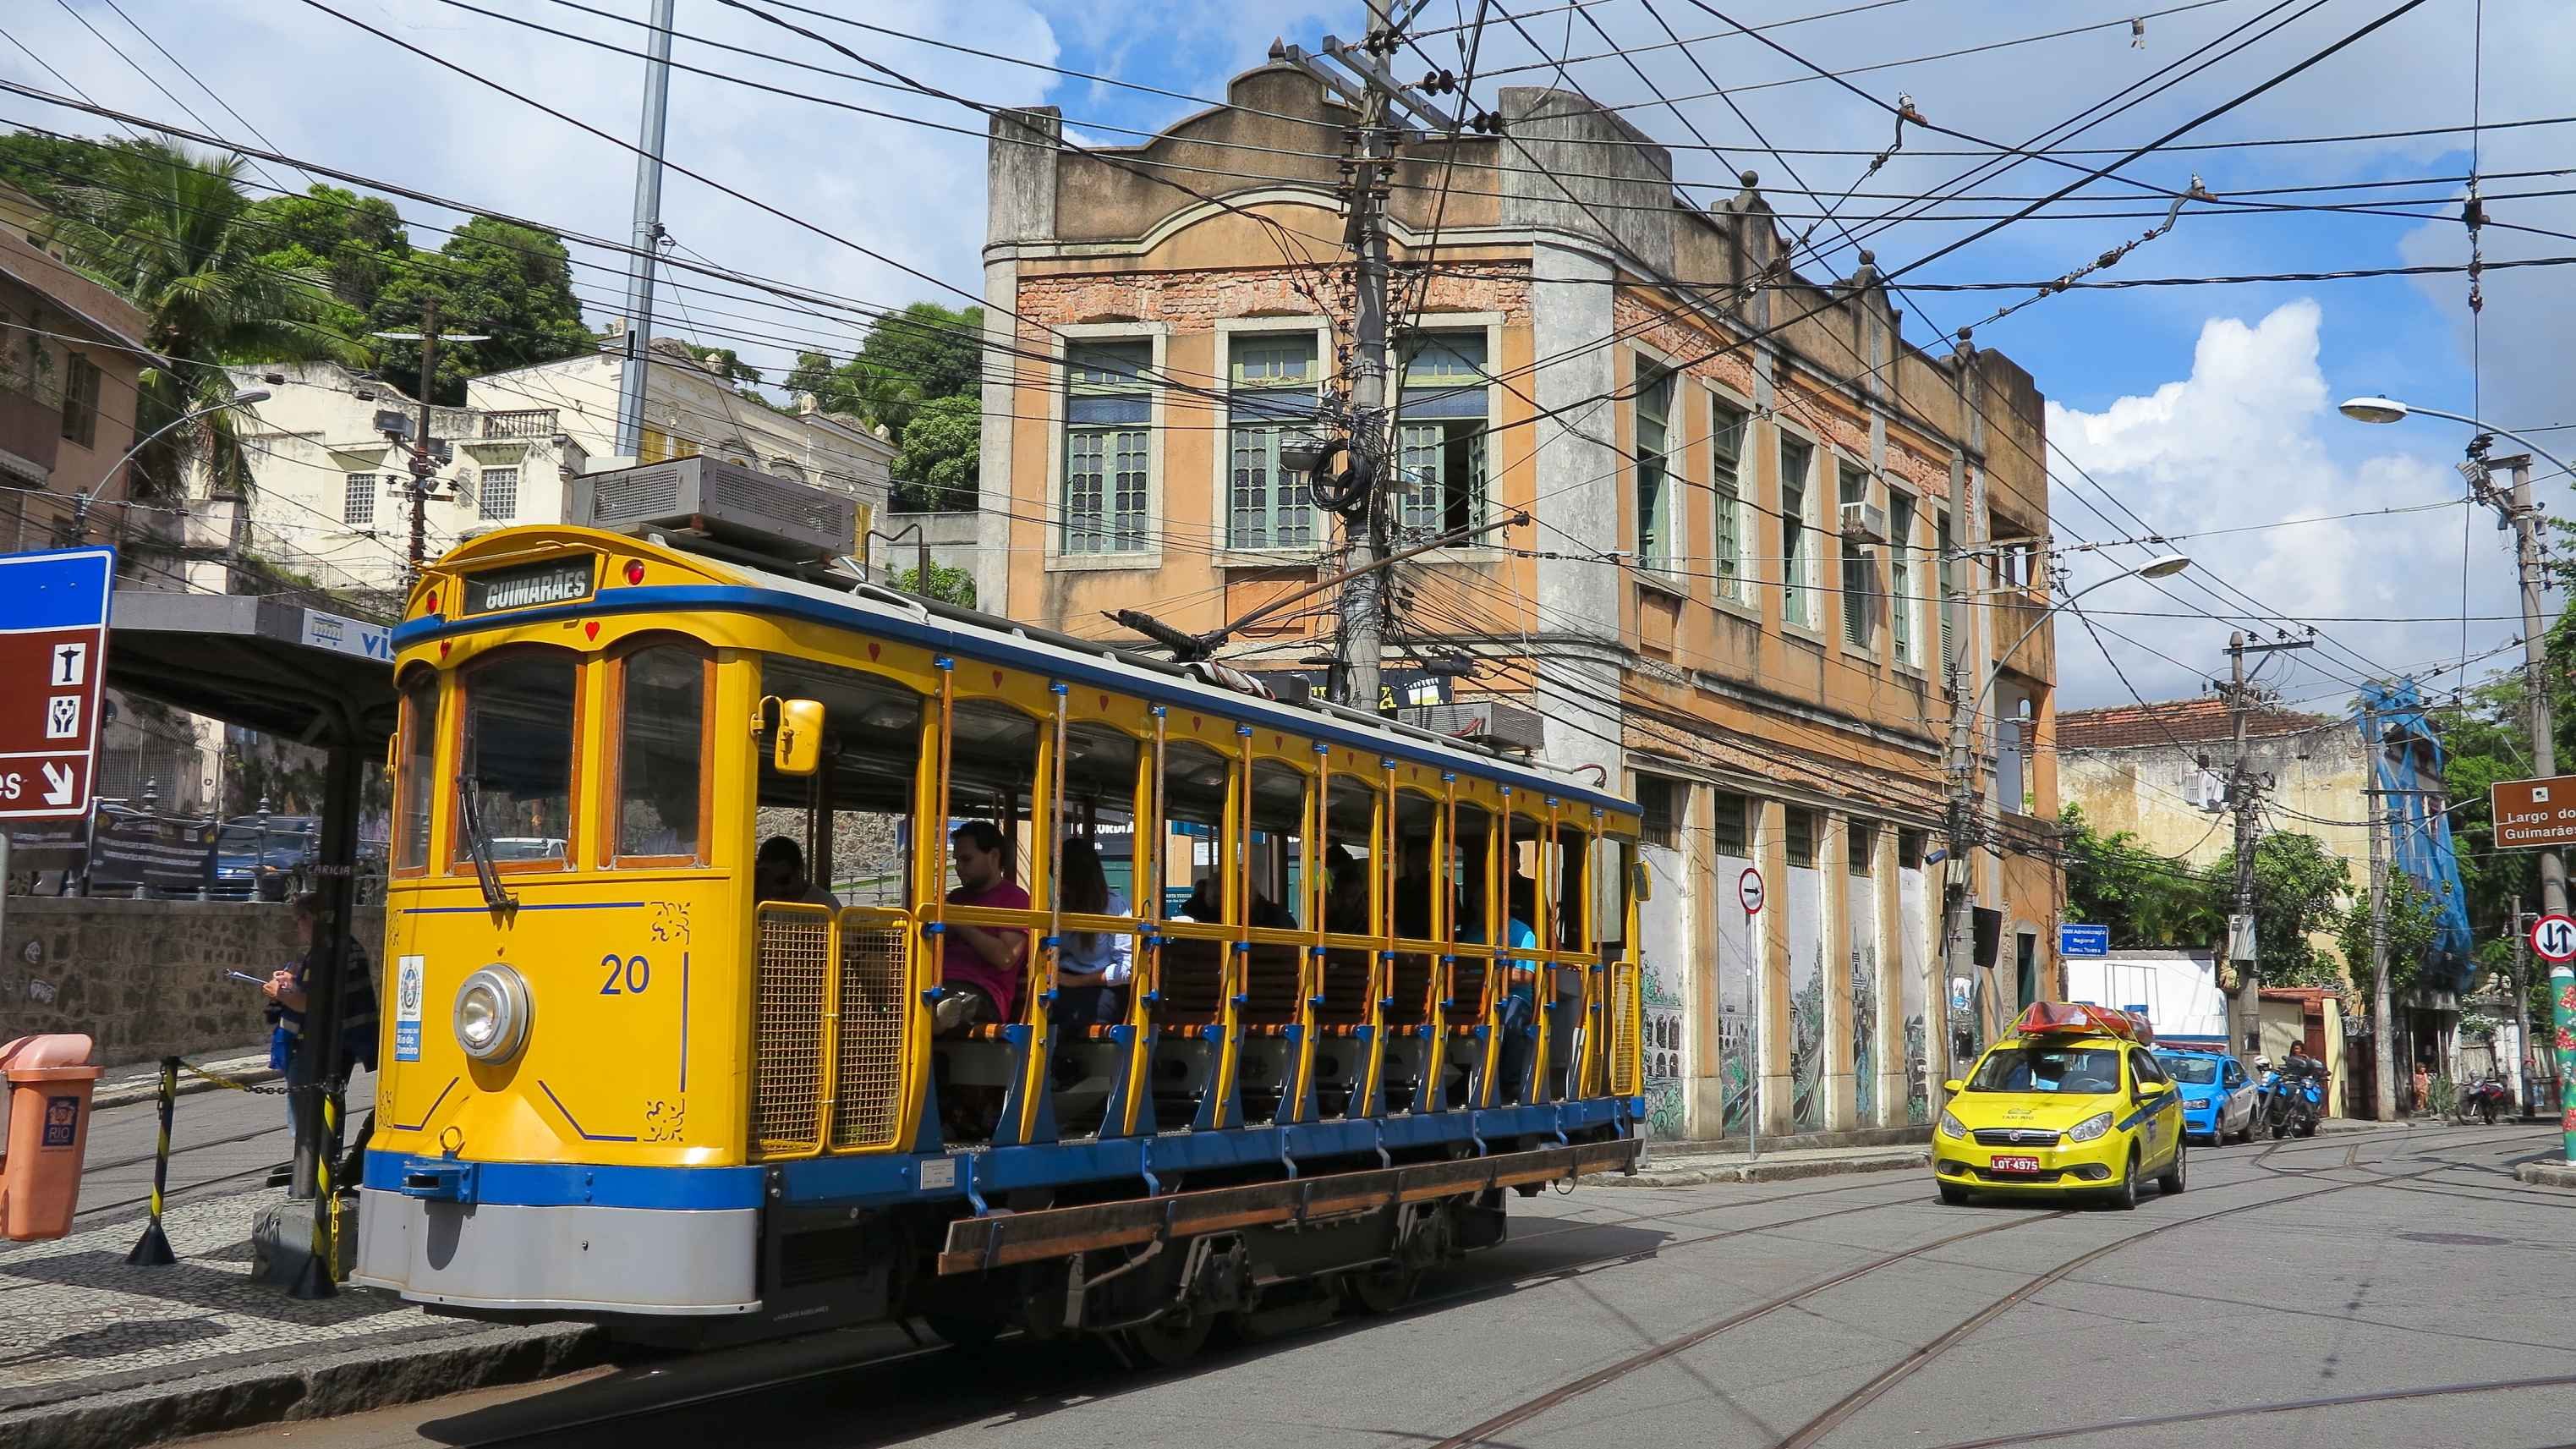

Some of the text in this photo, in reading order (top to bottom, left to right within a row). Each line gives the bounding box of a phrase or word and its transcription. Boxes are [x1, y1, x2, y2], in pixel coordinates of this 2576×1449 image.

[485, 568, 586, 610] GUIMARÃES
[362, 628, 396, 661] vi
[0, 772, 21, 799] s
[2507, 808, 2576, 824] Largo do
[600, 953, 649, 995] 20
[49, 1127, 69, 1139] RIO
